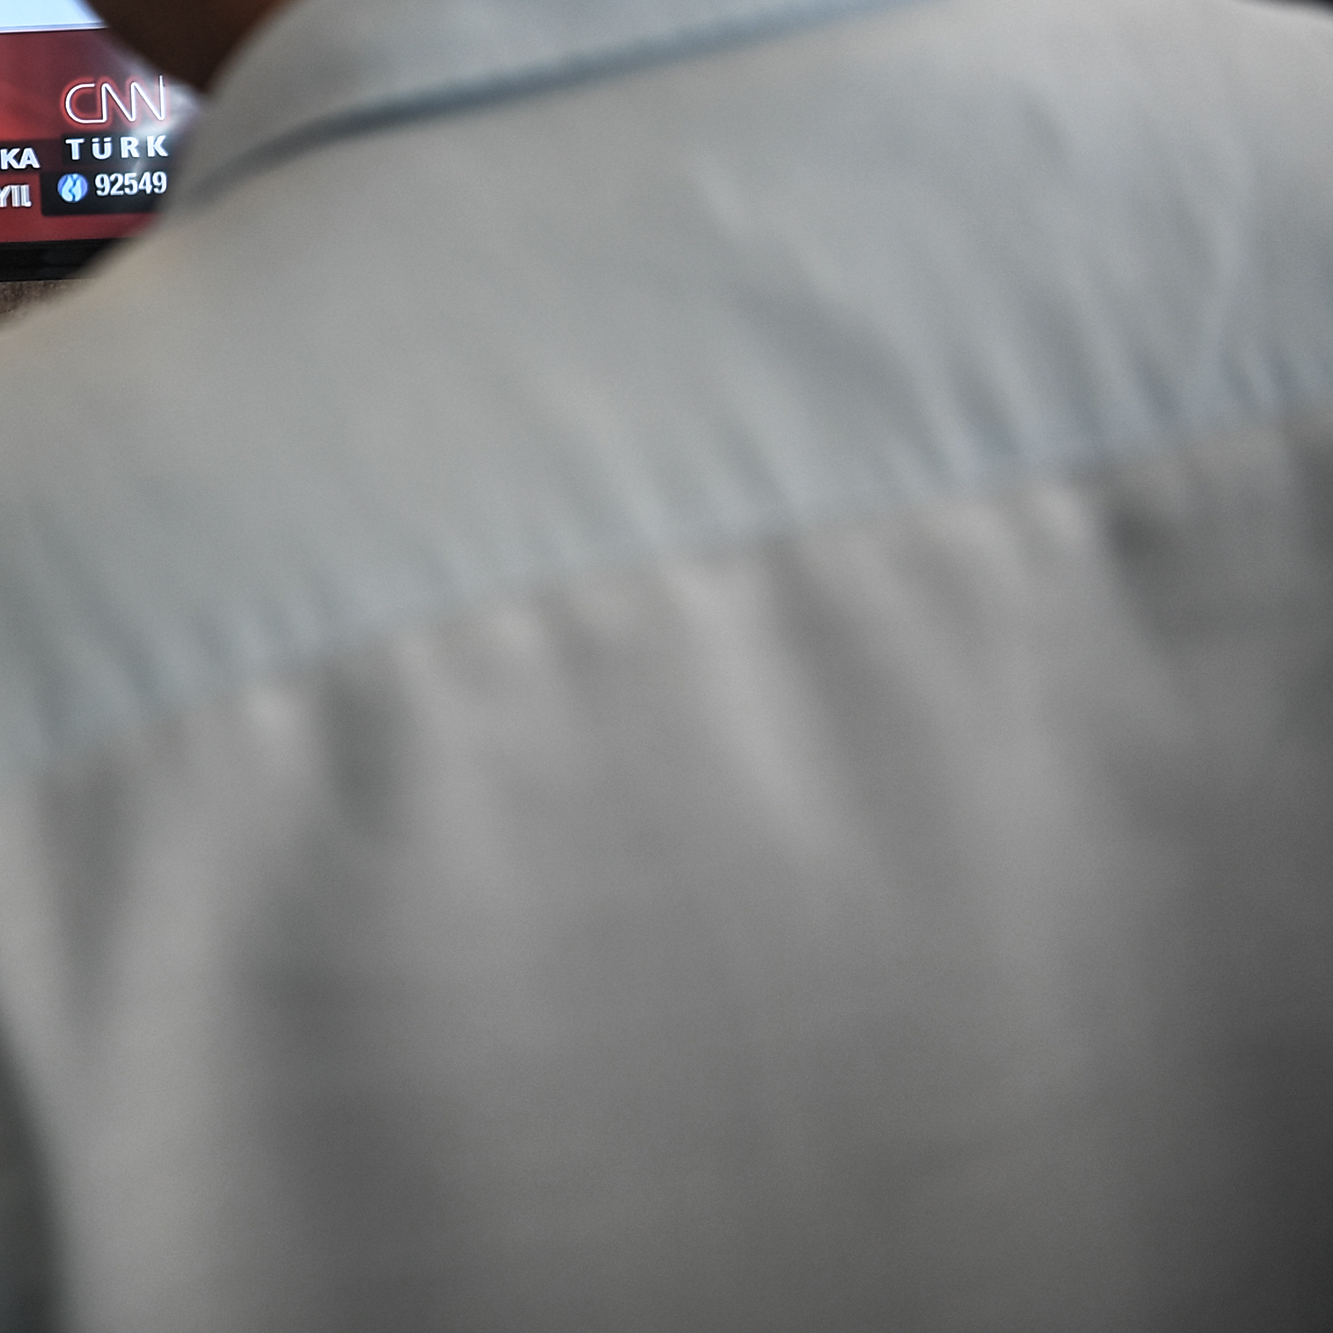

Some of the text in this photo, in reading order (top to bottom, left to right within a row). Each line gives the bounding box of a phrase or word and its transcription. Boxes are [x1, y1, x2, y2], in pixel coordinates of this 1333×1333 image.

[64, 74, 165, 124] CNN
[65, 135, 169, 160] TÜRK
[94, 170, 168, 197] 92549
